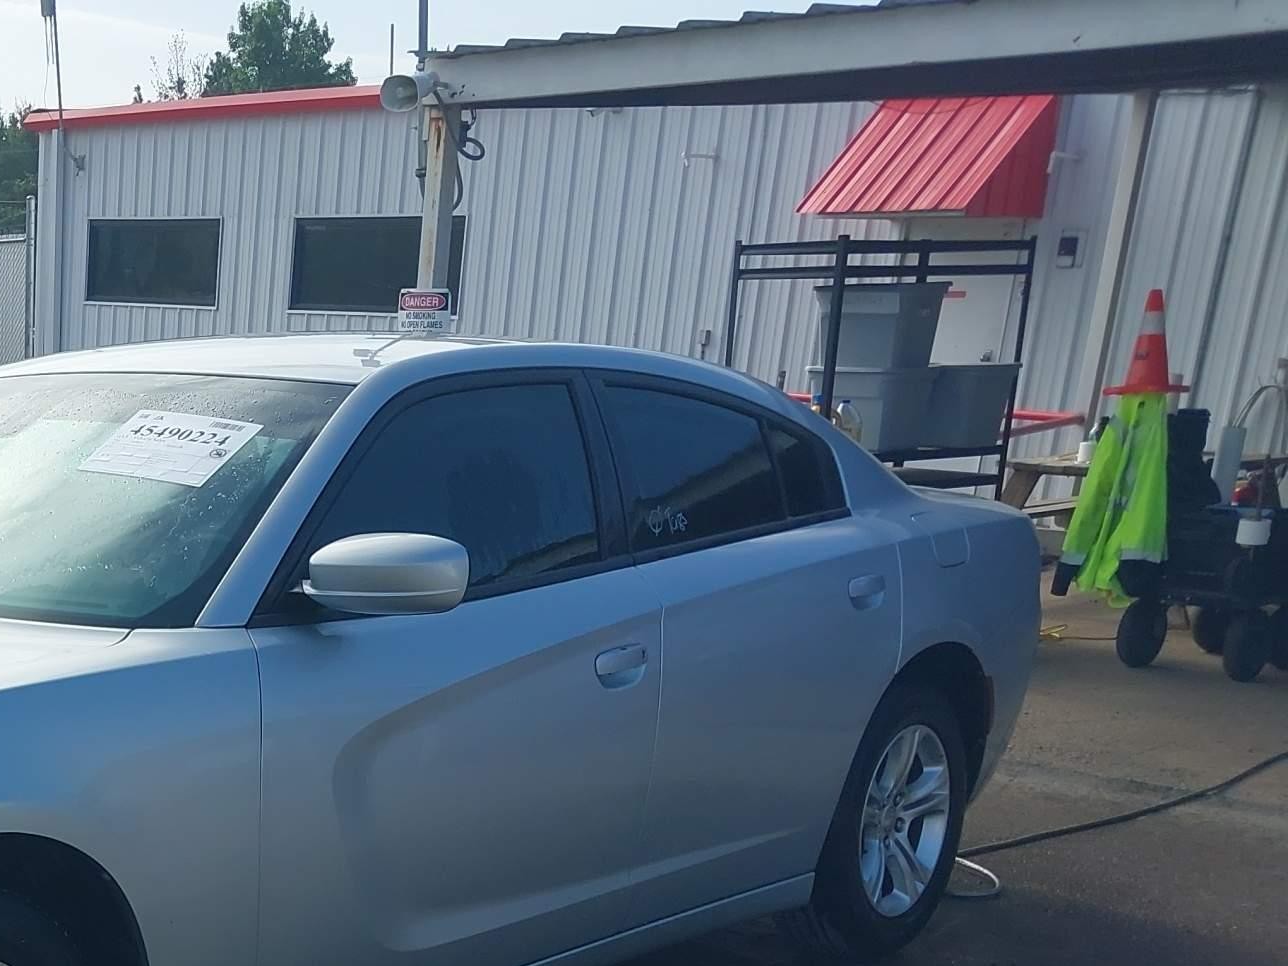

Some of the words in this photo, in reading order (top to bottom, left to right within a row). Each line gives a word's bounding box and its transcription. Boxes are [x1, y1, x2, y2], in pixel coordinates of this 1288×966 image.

[405, 296, 439, 307] DANGER
[412, 312, 436, 320] SMOKING
[130, 425, 232, 446] 45490224
